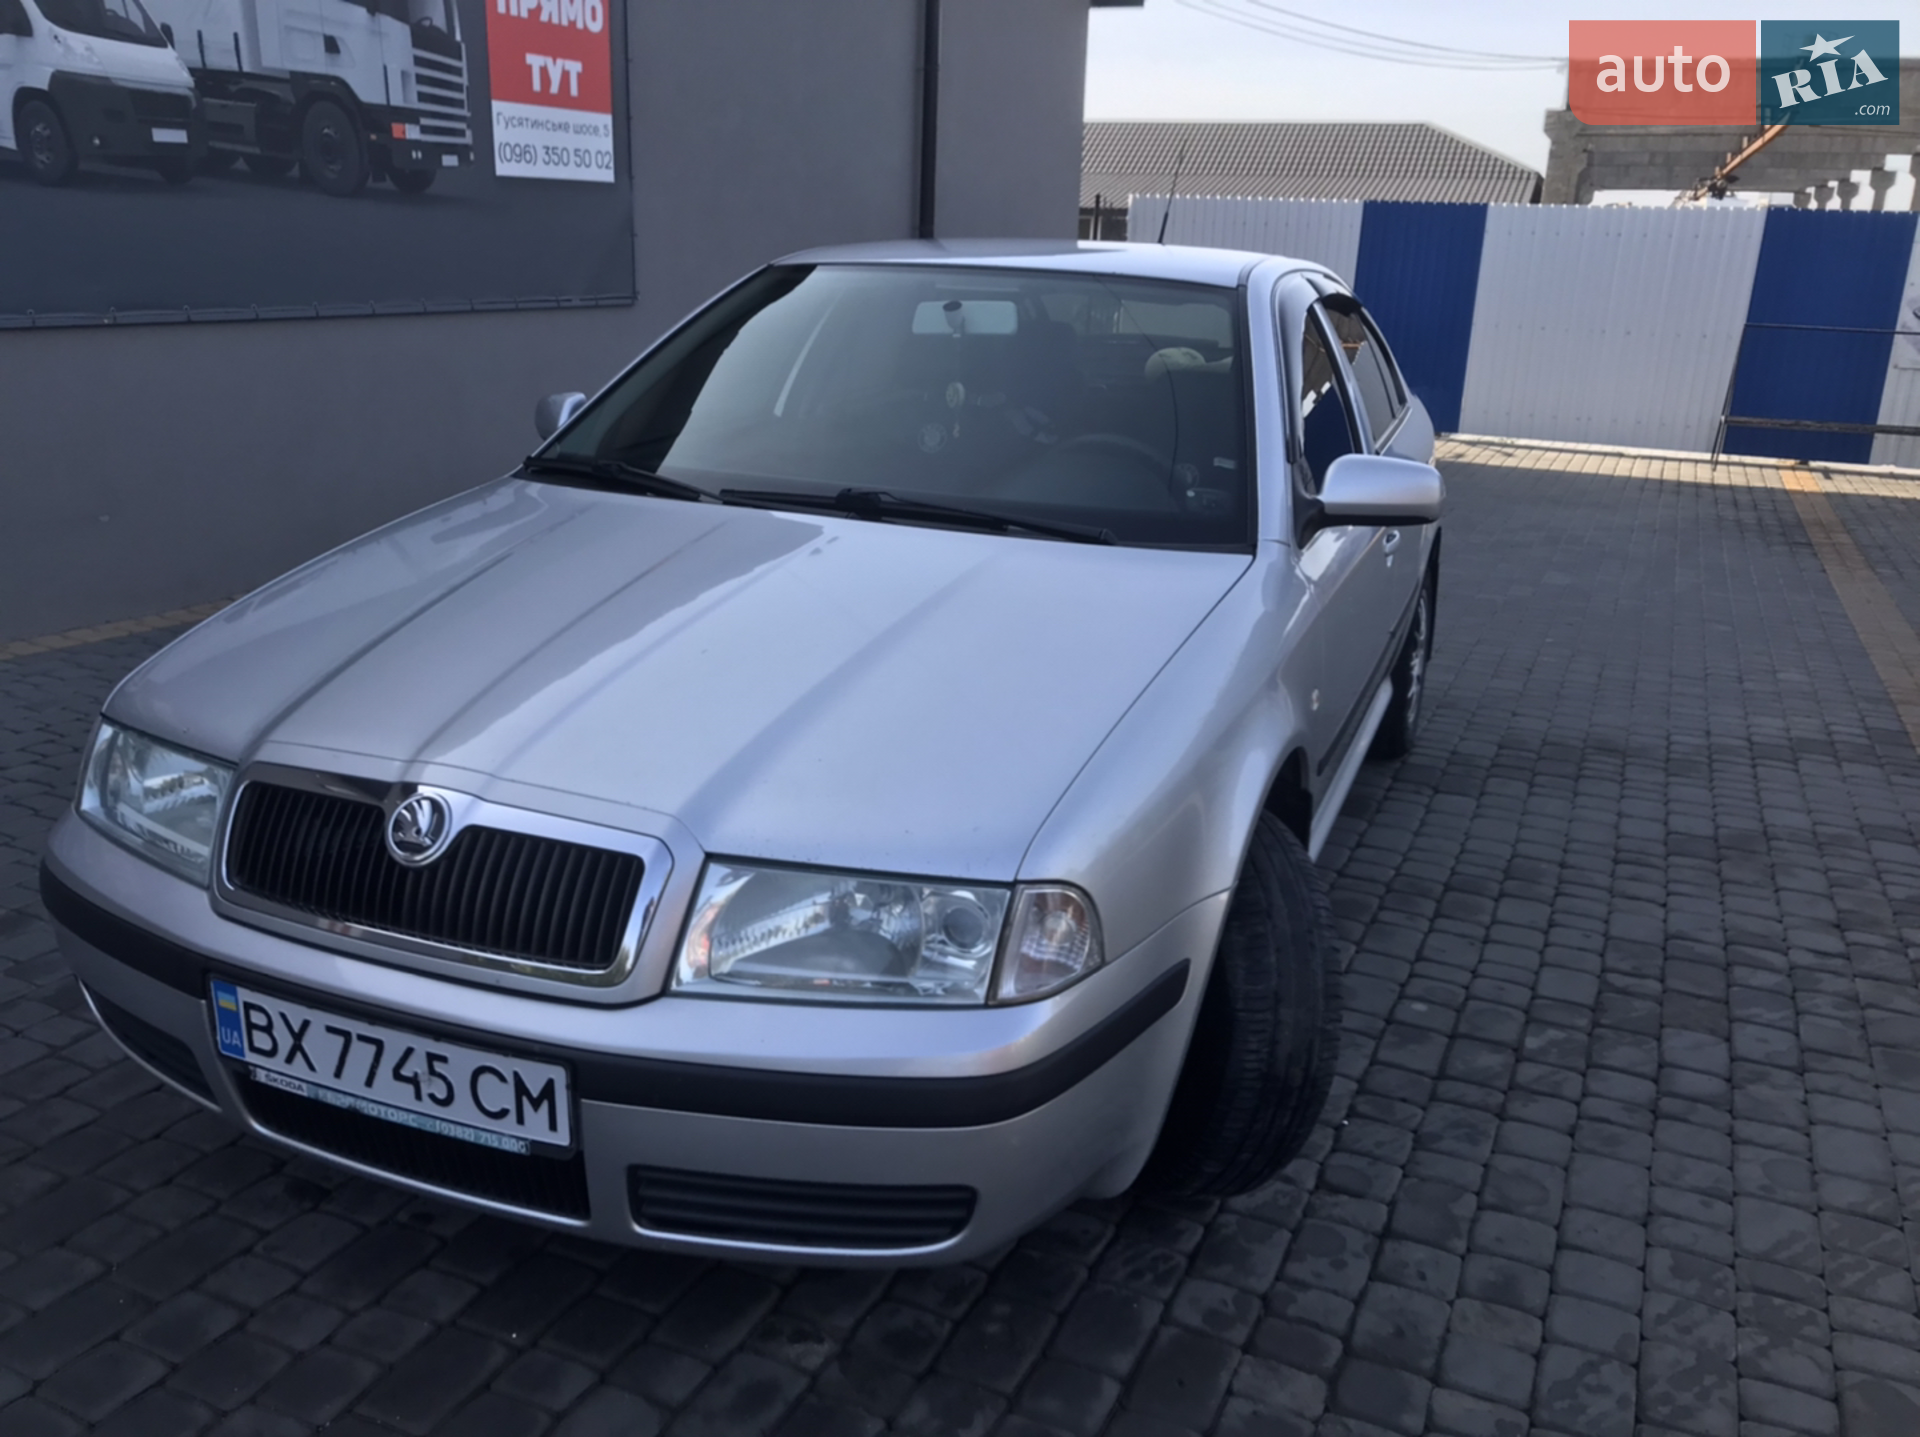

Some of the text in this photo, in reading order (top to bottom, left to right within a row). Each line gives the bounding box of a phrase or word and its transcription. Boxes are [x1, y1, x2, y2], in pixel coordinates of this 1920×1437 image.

[525, 52, 583, 98] ТУТ
[496, 112, 570, 134] Гусятинське
[603, 124, 610, 138] 5
[498, 142, 613, 170] (096) 350 50 02
[222, 1026, 242, 1048] UA
[242, 1000, 558, 1133] BX 7745 CM
